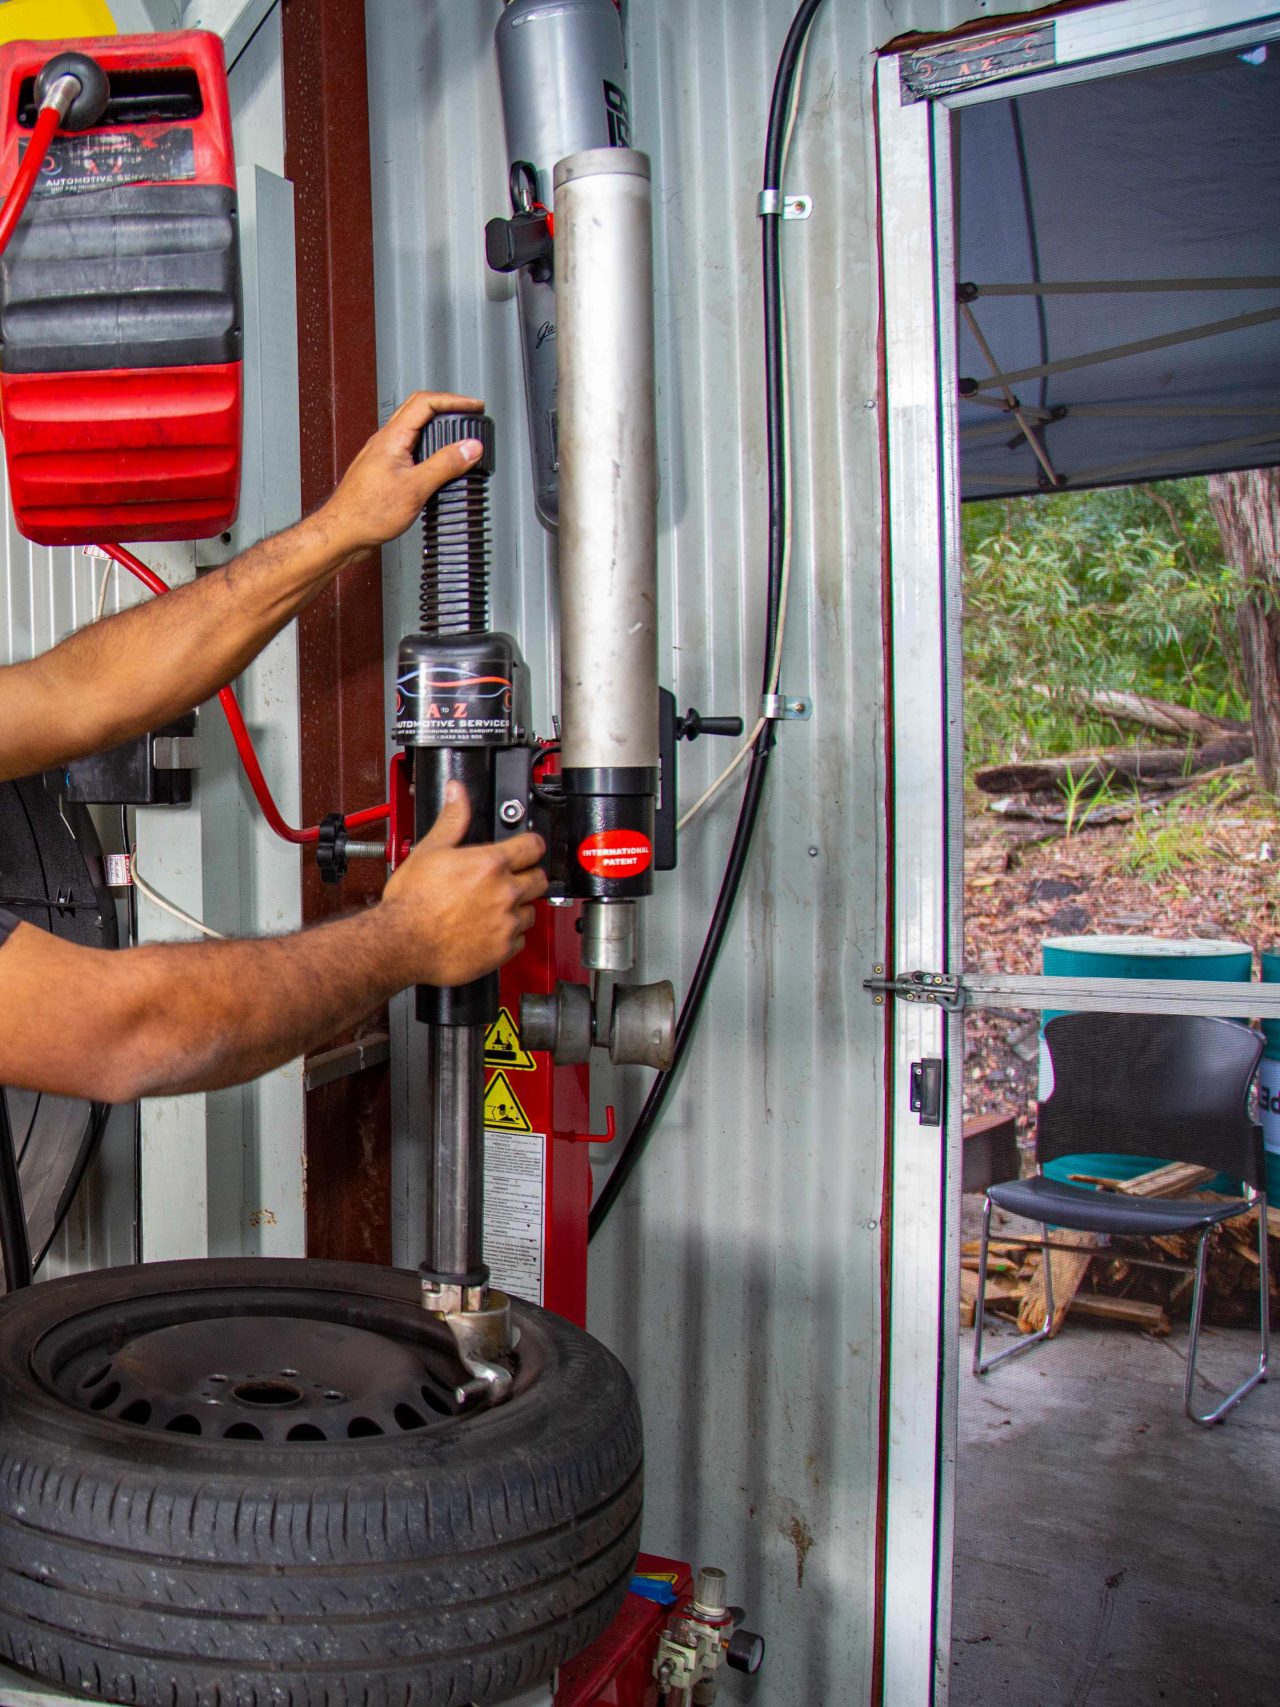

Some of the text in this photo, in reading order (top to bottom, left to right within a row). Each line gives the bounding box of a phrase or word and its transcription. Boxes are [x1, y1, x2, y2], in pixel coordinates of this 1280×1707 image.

[426, 703, 441, 719] A
[453, 703, 468, 719] Z
[459, 719, 510, 728] SERVICES
[582, 846, 650, 857] INTERNATIONAL
[602, 857, 638, 866] PATENT
